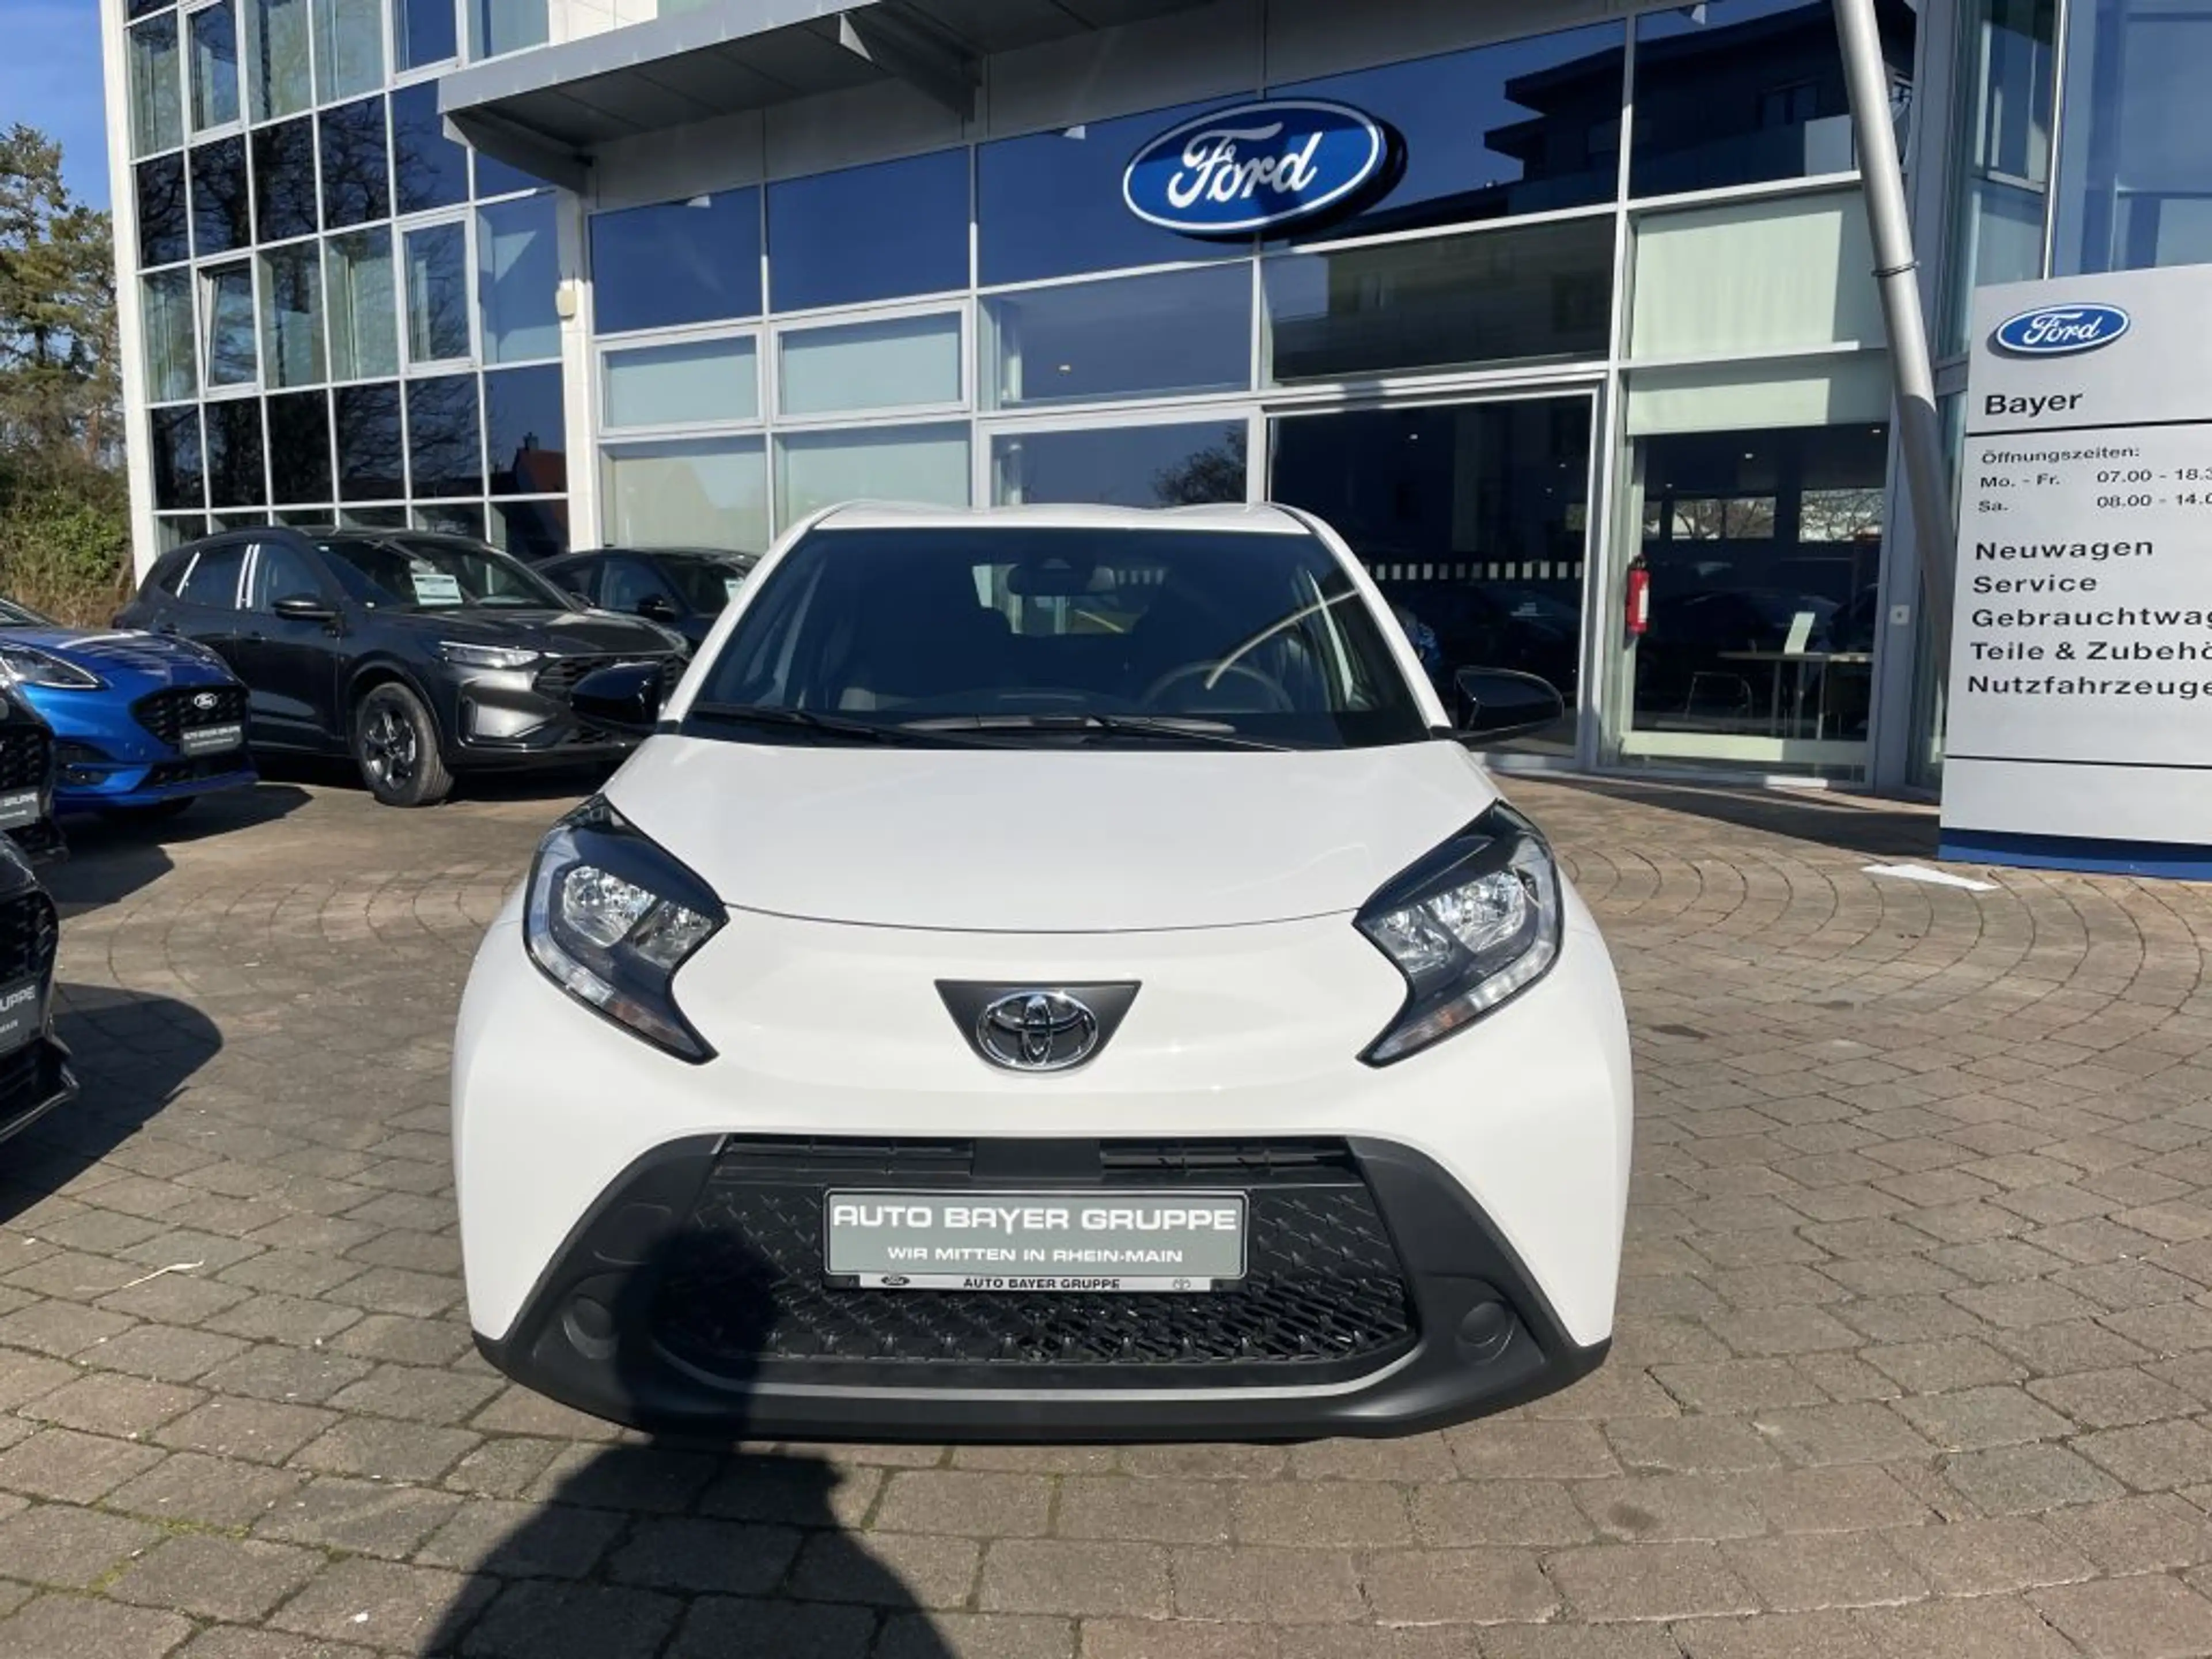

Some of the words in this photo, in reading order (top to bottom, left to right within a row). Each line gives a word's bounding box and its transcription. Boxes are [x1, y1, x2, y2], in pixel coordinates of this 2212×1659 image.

[1167, 122, 1322, 209] Ford
[2022, 311, 2104, 346] Ford
[1985, 393, 2082, 418] Bayer
[1981, 447, 2139, 464] Öffnungszeiten:
[1980, 476, 2014, 488] Mo.
[2037, 473, 2059, 485] Fr.
[2097, 469, 2152, 483] 07.00
[1978, 501, 2008, 513] Sa.
[2097, 494, 2152, 508] 08.00
[1976, 541, 2153, 560] Neuwagen
[1972, 574, 2096, 594] Service
[1970, 642, 2044, 660] Teile
[2055, 642, 2075, 660] &
[834, 1205, 932, 1228] AUTO
[944, 1207, 1069, 1234] BAYER
[1081, 1209, 1236, 1230] GRUPPE
[888, 1247, 927, 1259] WIR
[935, 1248, 1016, 1261] MITTEN
[1024, 1249, 1045, 1262] IN
[963, 1278, 1003, 1289] AUTO
[1008, 1279, 1056, 1289] BAYER
[1060, 1279, 1120, 1289] GRUPPE
